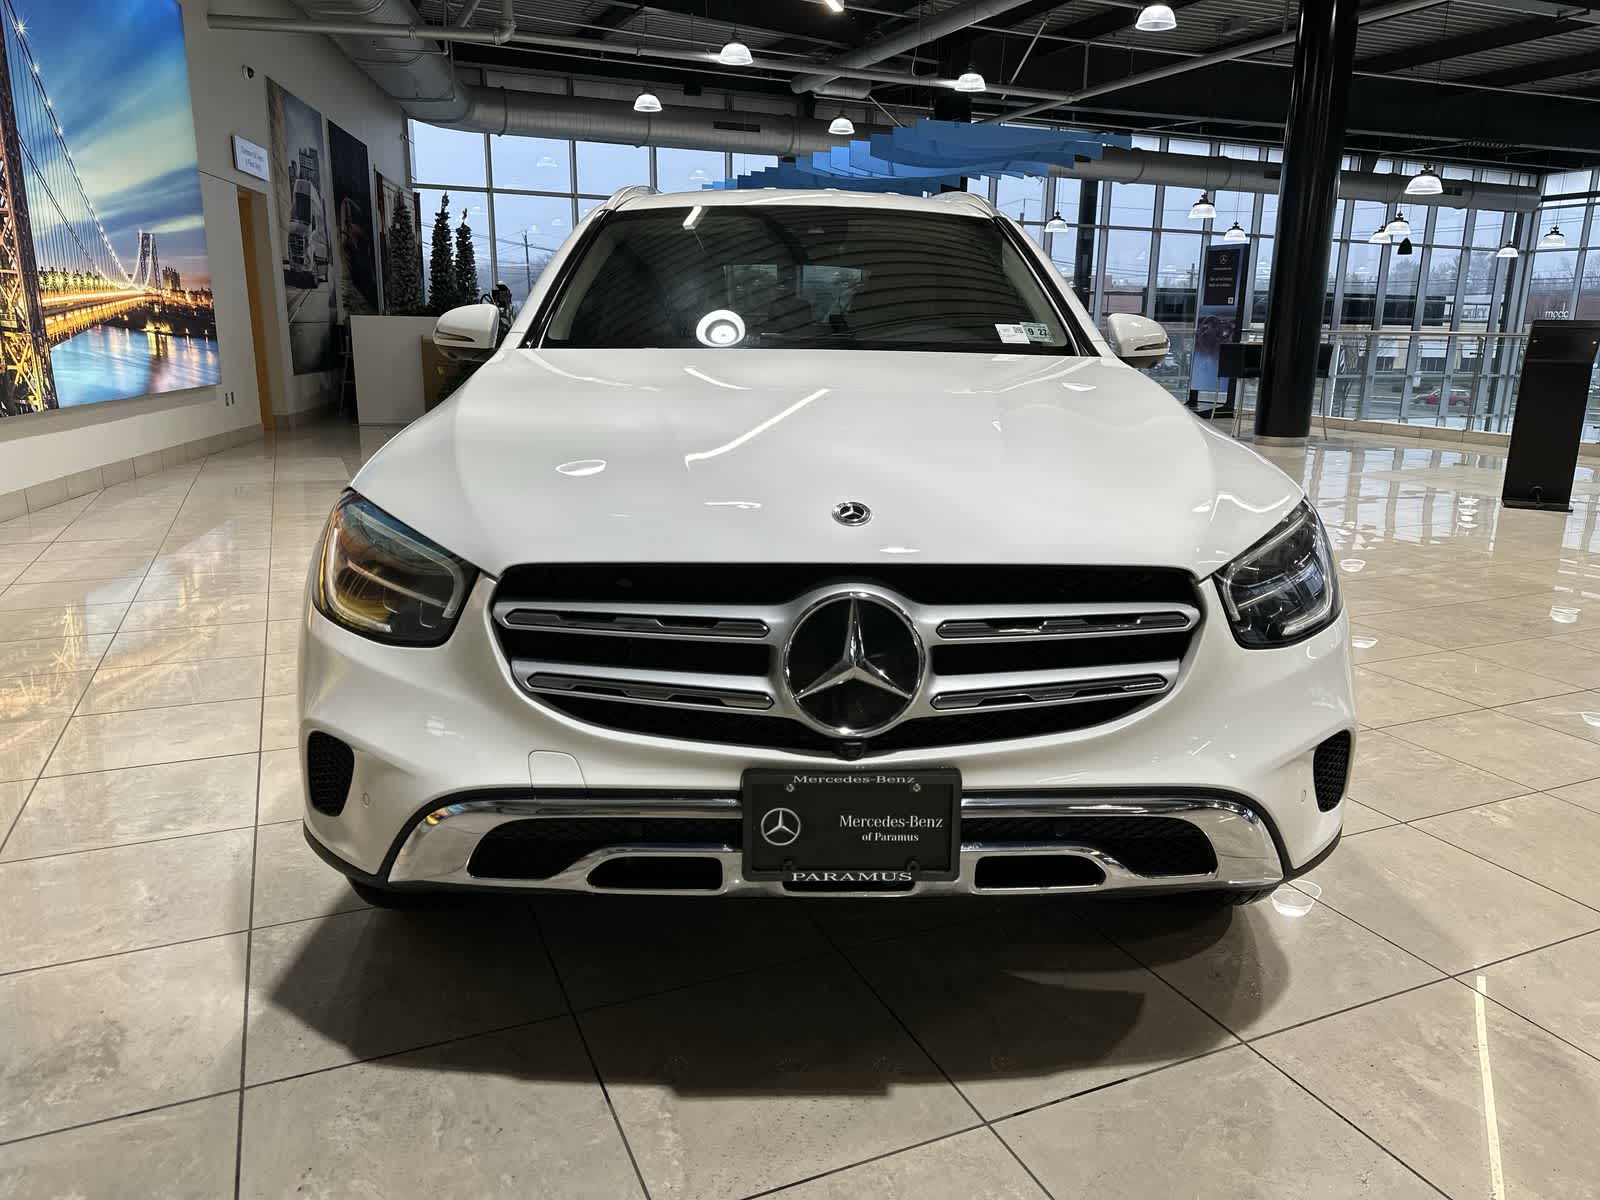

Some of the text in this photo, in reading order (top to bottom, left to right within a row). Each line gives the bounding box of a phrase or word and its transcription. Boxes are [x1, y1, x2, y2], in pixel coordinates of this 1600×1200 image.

[1028, 327, 1035, 336] 9
[792, 775, 915, 784] Mercedes-Benz
[839, 815, 943, 828] Mercedes-Benz
[861, 832, 919, 842] of Paramus
[791, 872, 913, 881] PARAMUS
